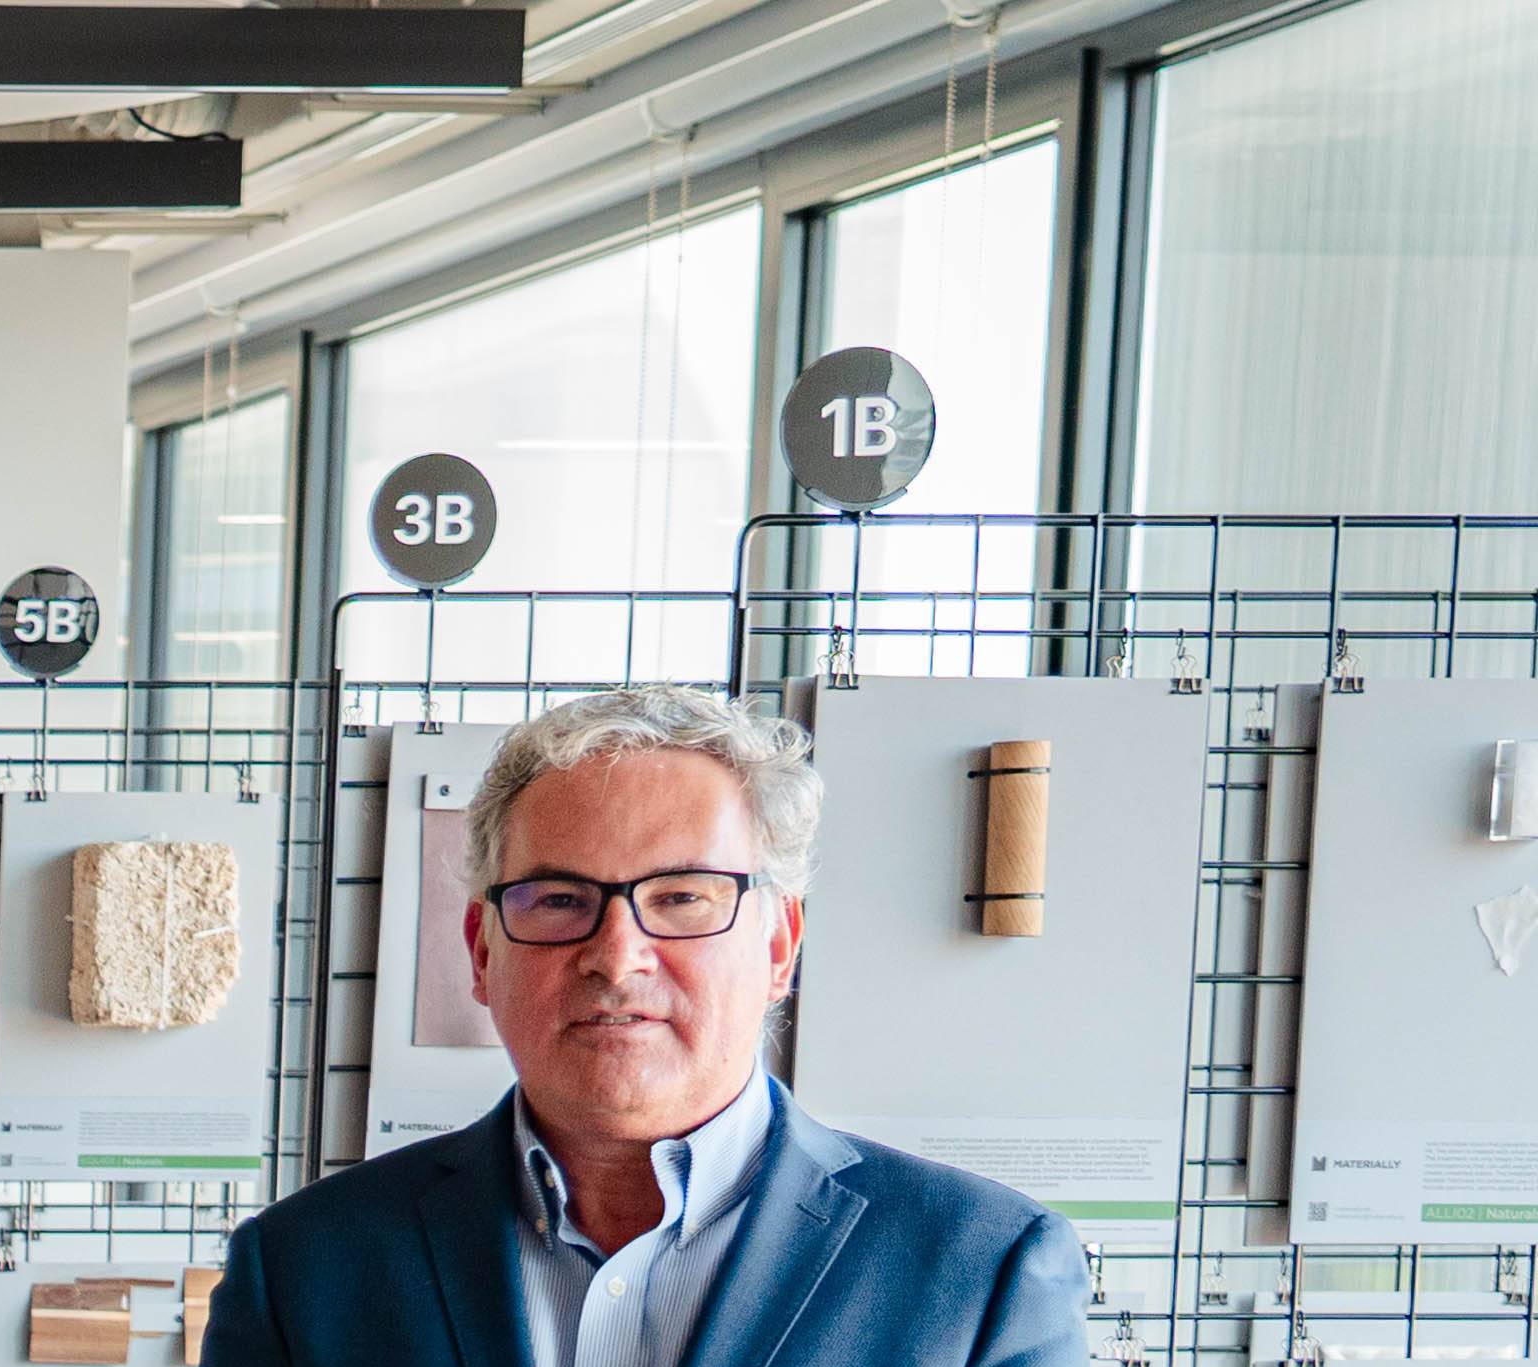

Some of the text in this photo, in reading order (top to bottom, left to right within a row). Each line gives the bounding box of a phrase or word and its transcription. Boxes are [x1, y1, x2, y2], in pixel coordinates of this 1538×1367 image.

[820, 396, 897, 458] 1B
[393, 493, 475, 545] 3B
[13, 600, 79, 643] 5B
[397, 1122, 455, 1131] MATERIALLY
[1333, 1159, 1401, 1169] MATERIALLY
